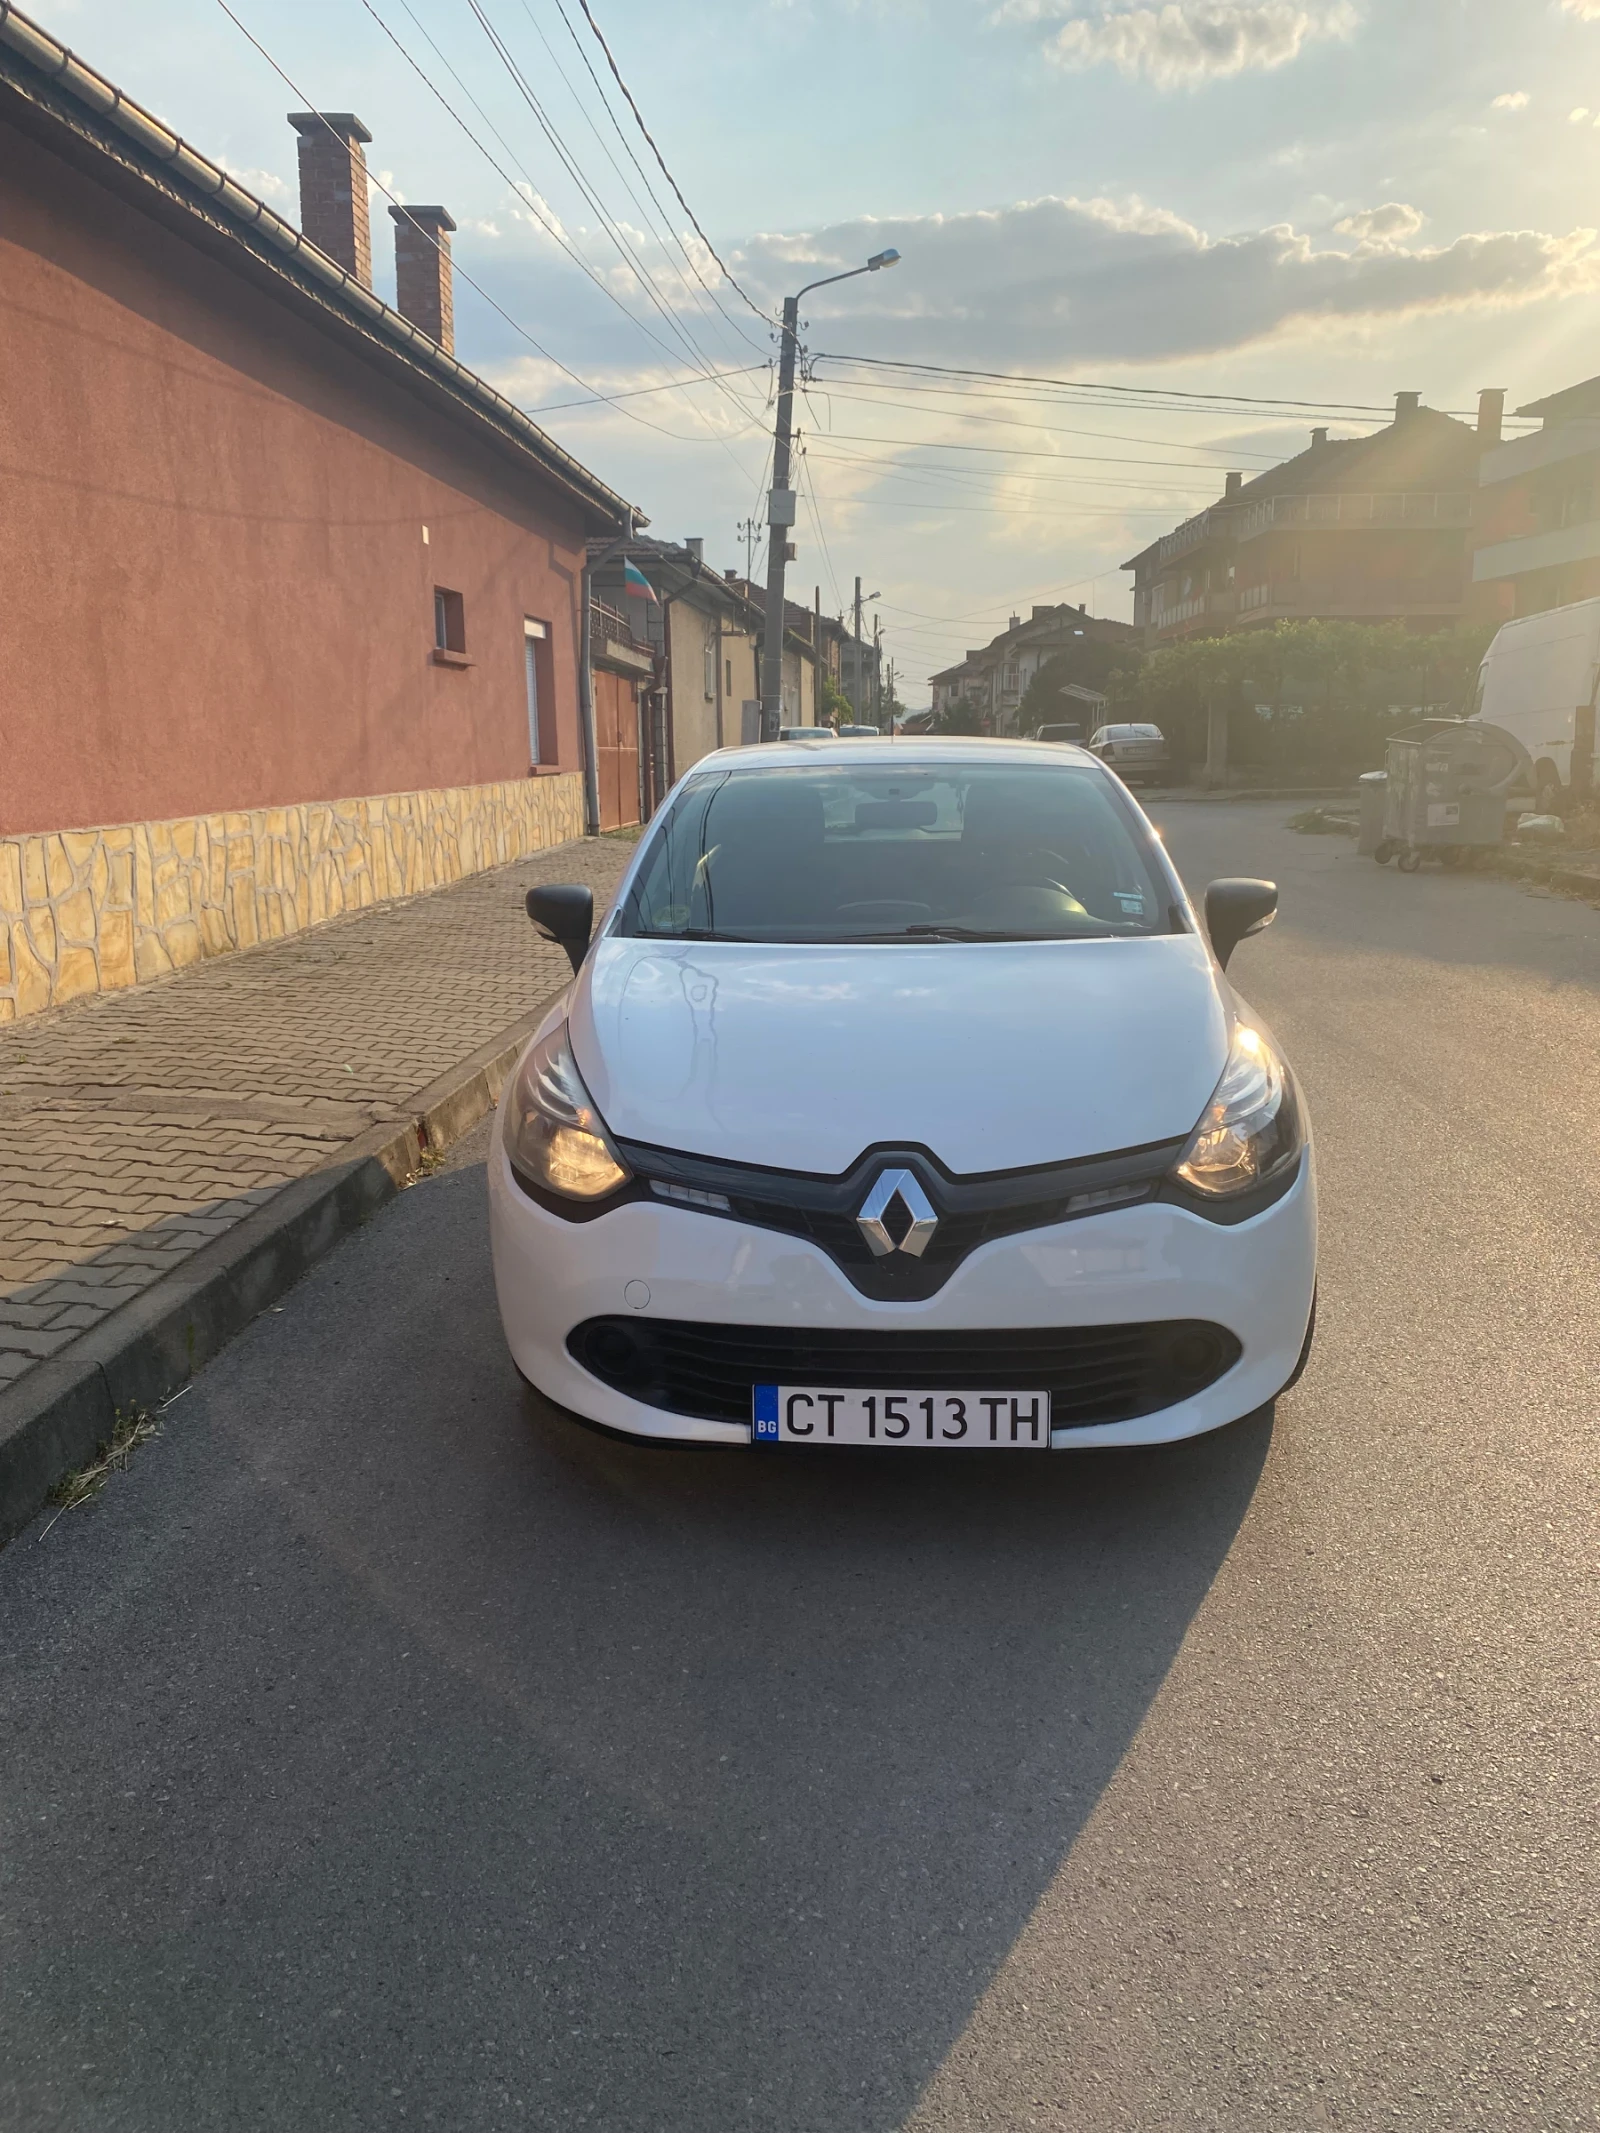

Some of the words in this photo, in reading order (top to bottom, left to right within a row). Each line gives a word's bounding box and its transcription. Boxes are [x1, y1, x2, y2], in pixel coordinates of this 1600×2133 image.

[757, 1420, 777, 1433] BG
[786, 1393, 845, 1436] CT
[862, 1396, 968, 1440] 1513
[979, 1397, 1039, 1441] TH
